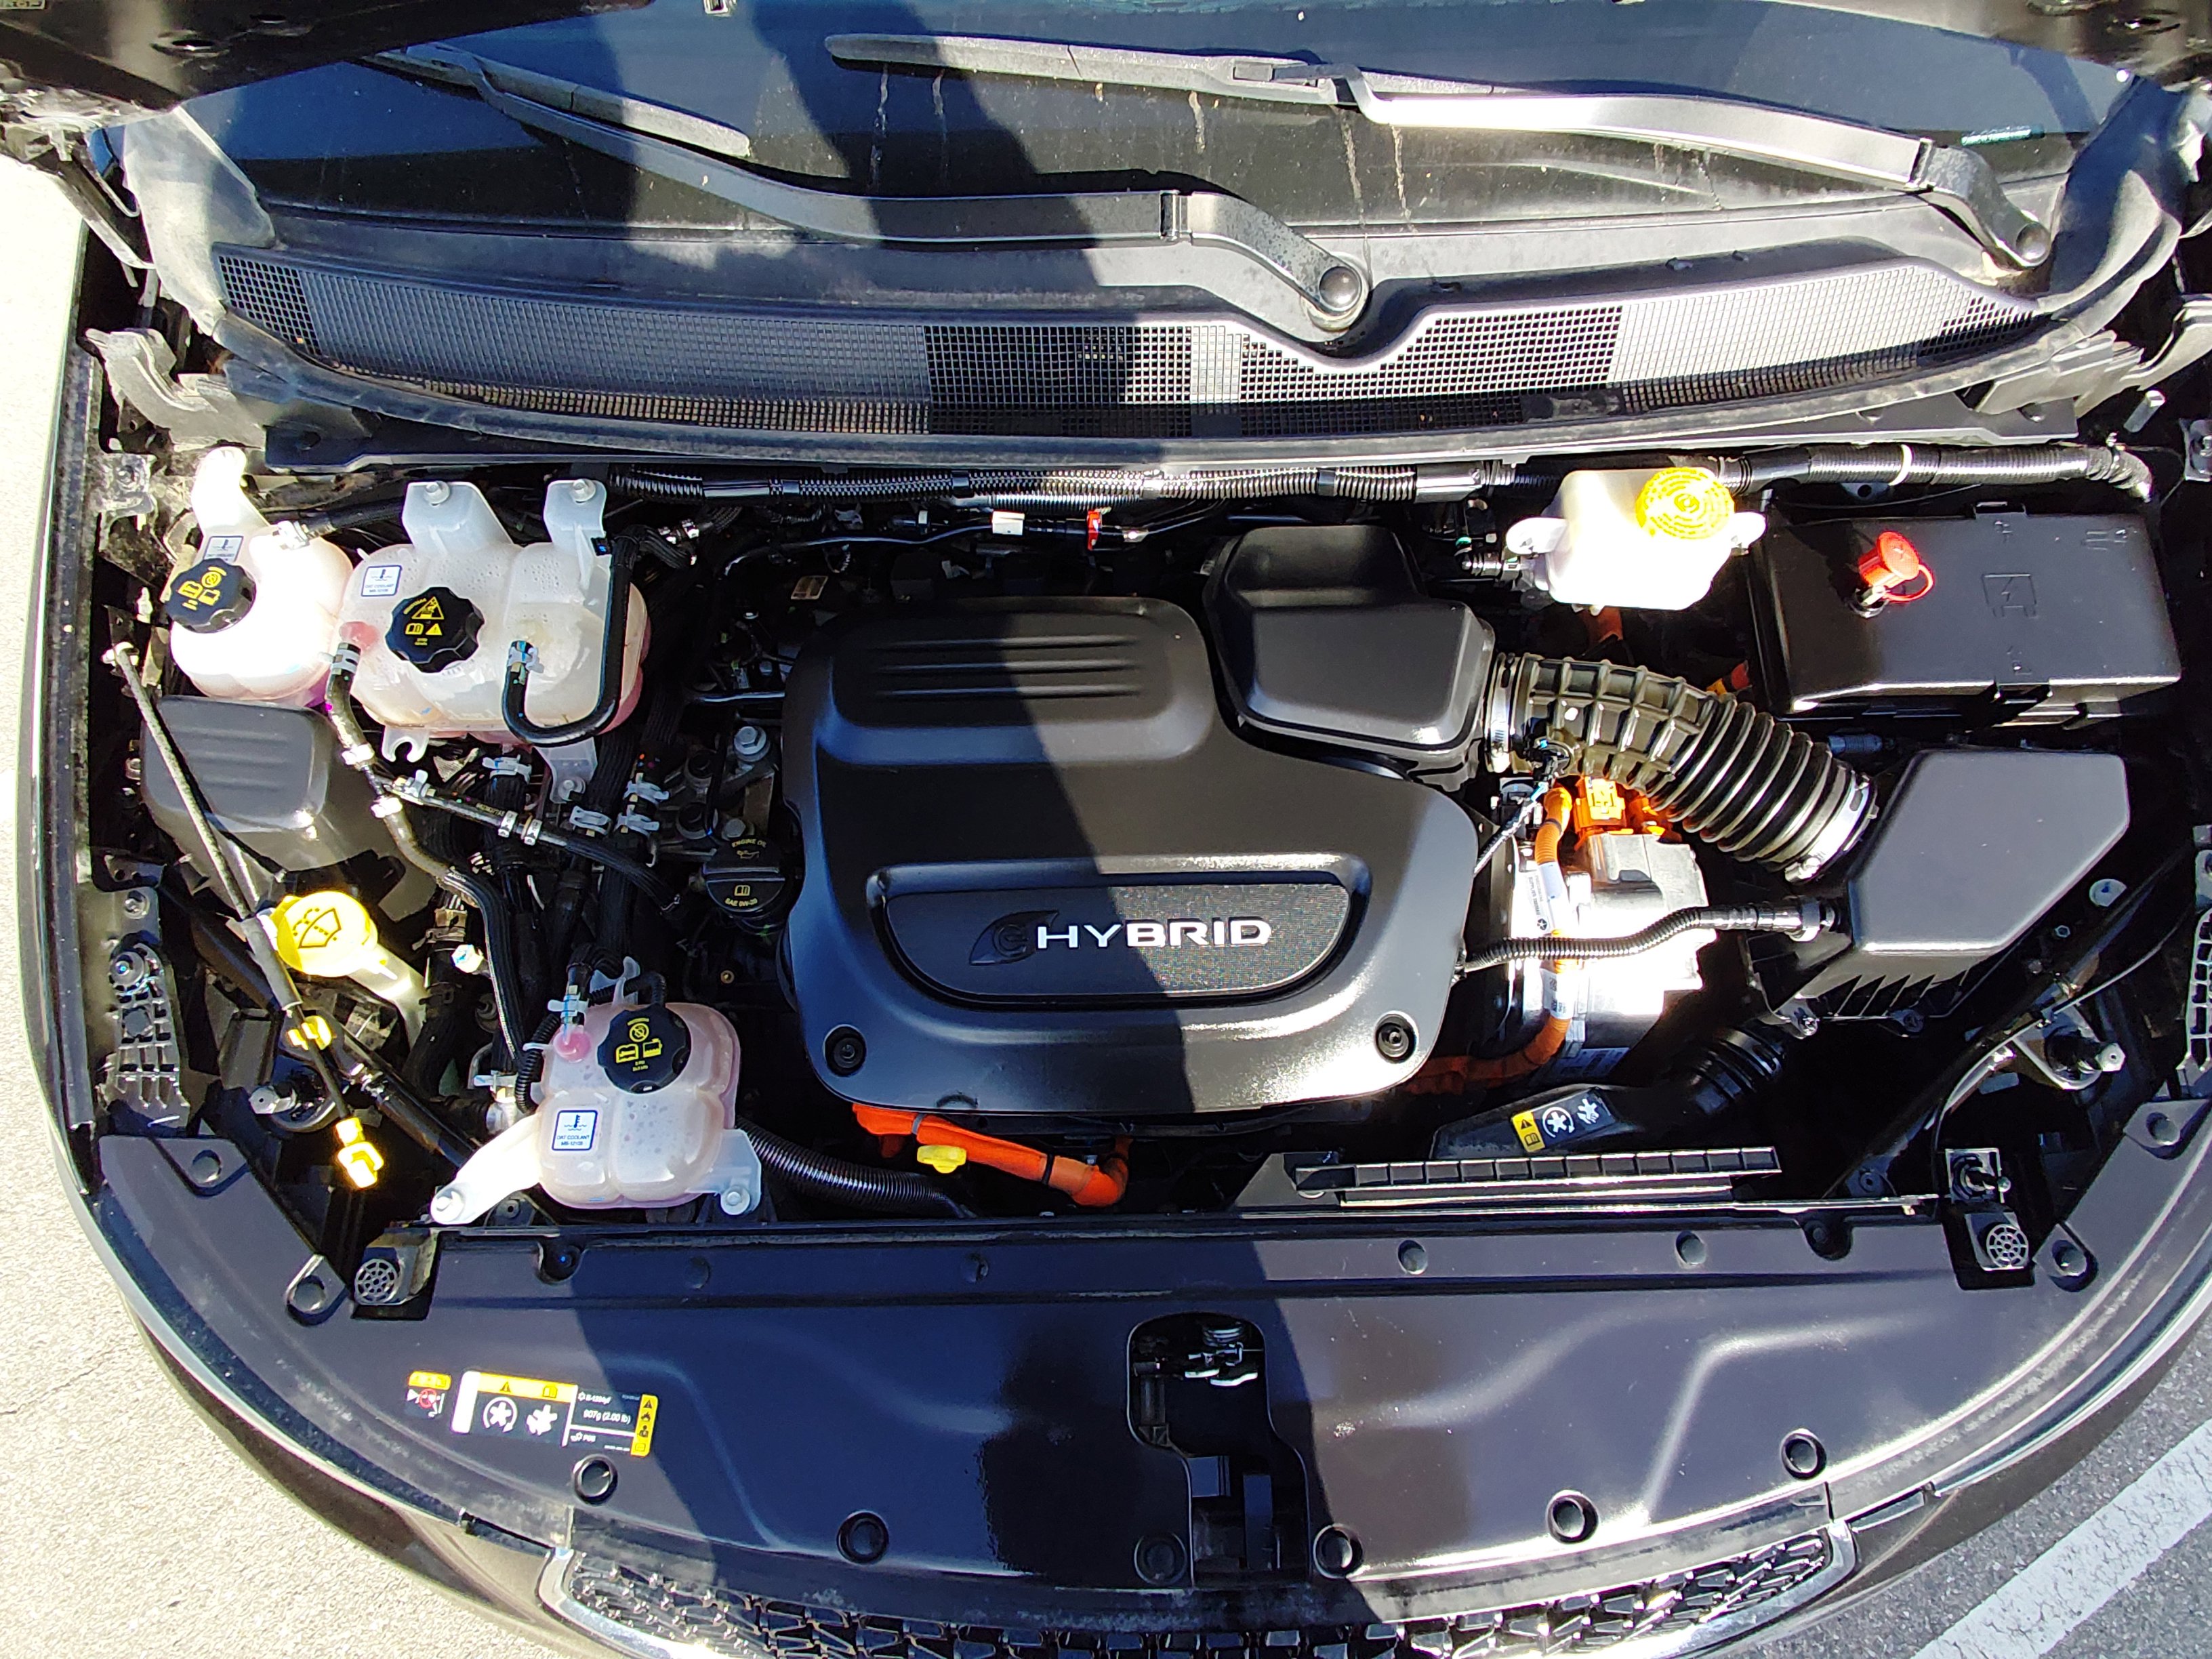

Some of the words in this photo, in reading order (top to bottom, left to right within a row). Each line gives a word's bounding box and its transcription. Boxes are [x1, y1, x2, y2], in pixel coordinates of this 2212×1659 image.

[732, 838, 756, 848] ENGINE
[724, 898, 738, 907] SAE
[1037, 920, 1272, 950] HYBRID
